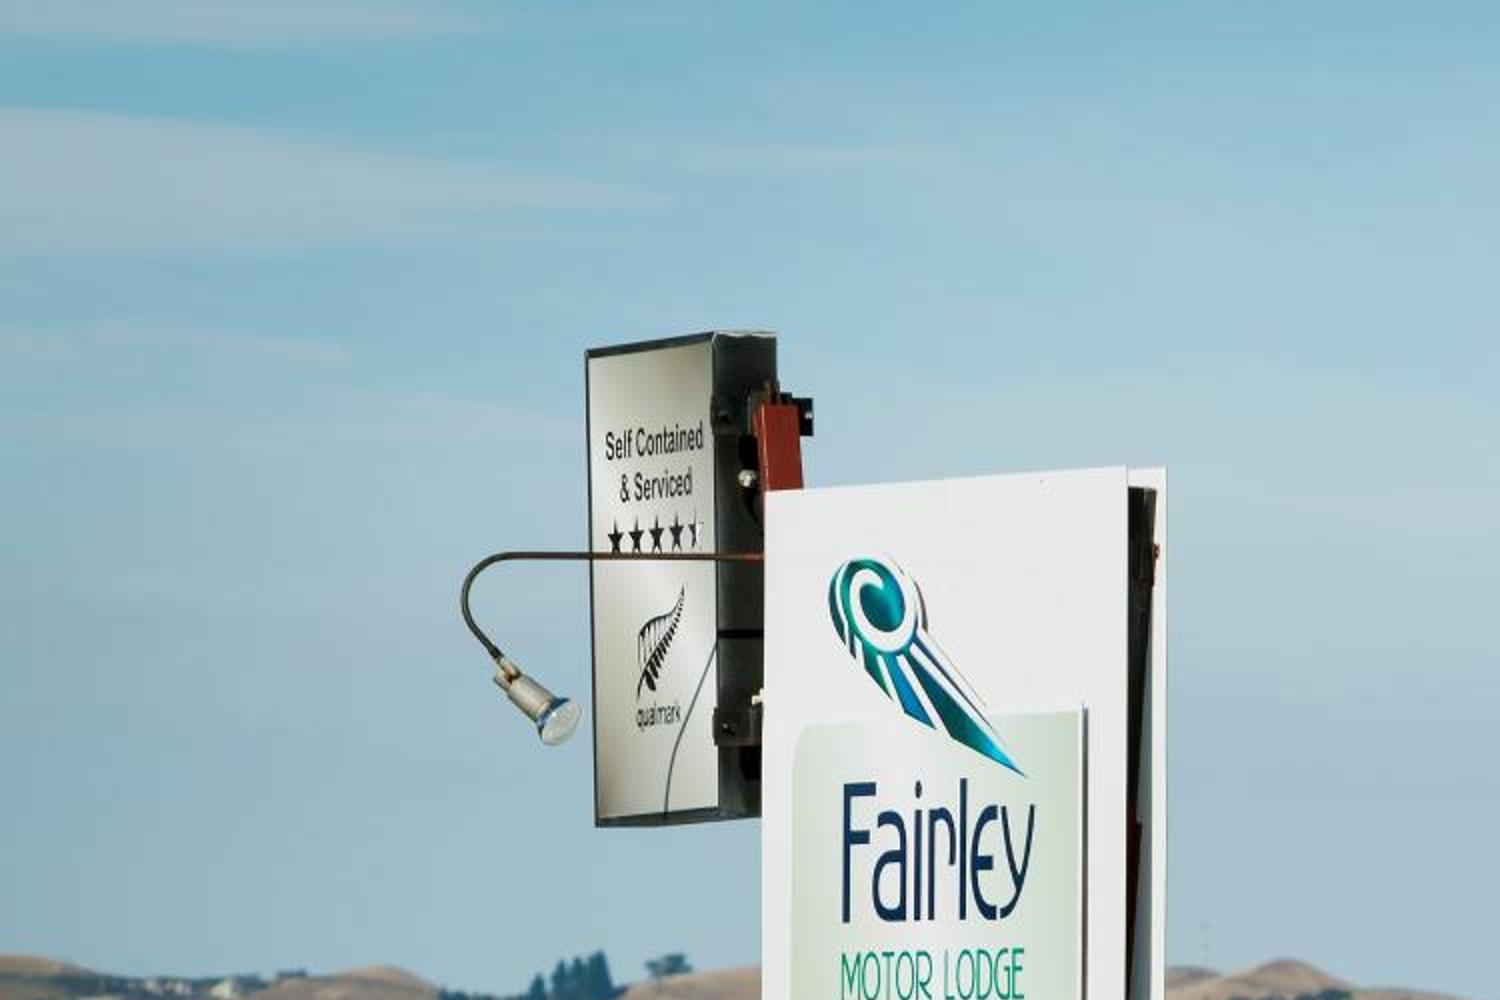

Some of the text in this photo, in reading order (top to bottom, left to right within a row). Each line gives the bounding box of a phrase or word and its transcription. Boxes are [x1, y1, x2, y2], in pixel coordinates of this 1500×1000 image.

[605, 420, 704, 461] Self Contained
[620, 467, 693, 503] & Serviced
[636, 701, 682, 732] qualmark
[842, 778, 1036, 923] Fairley
[943, 947, 1025, 1000] LODGE
